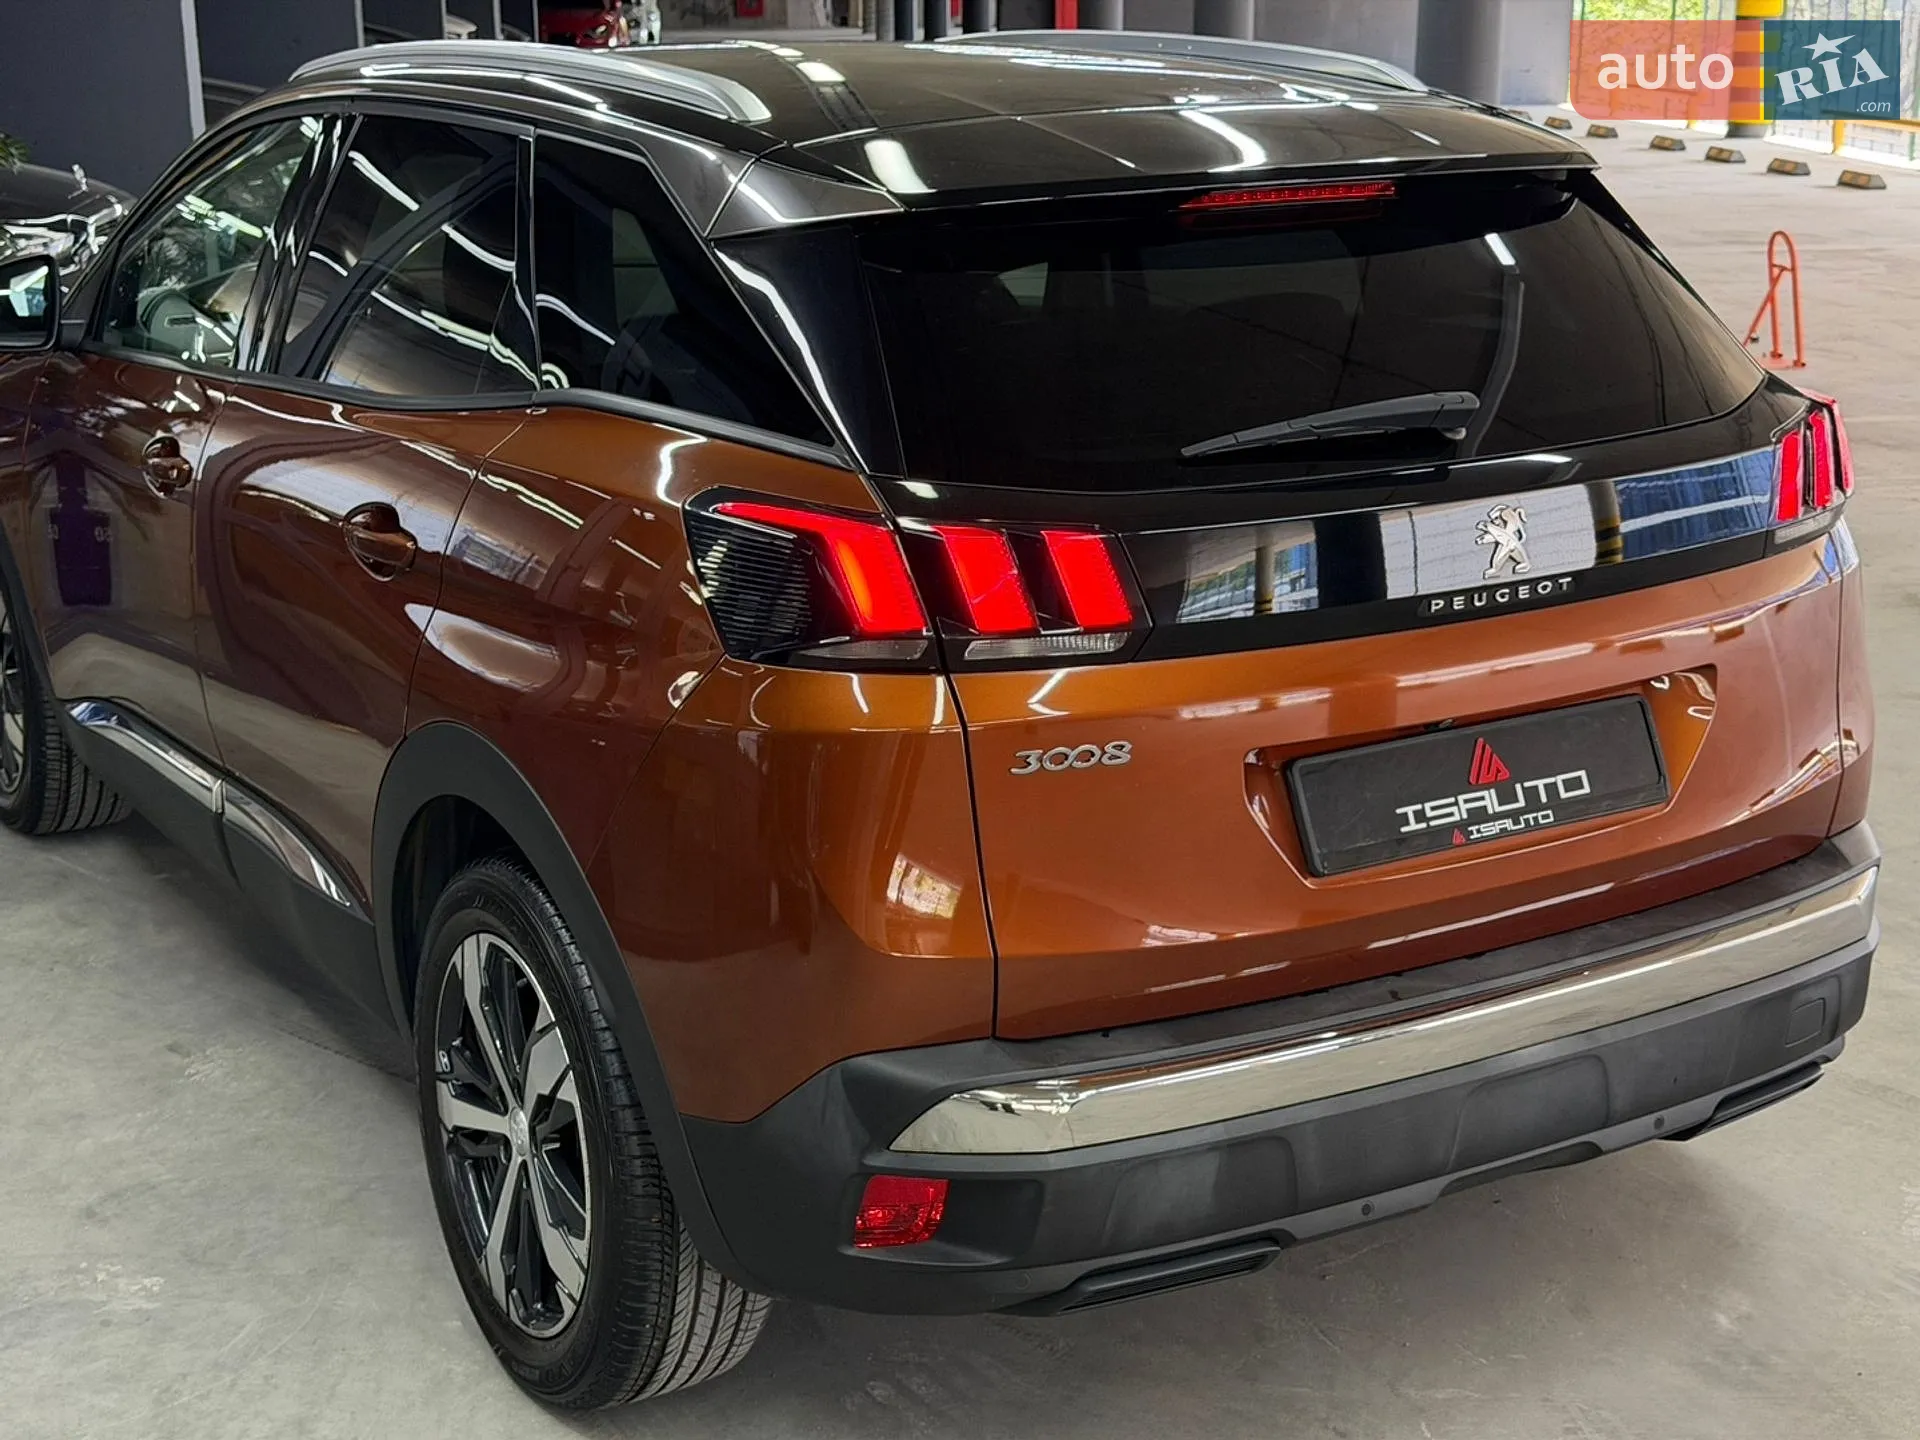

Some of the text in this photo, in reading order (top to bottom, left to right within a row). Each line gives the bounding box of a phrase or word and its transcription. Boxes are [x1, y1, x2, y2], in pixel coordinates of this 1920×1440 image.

[1430, 576, 1572, 613] PEUGEOT
[1010, 741, 1133, 774] 3008
[1395, 769, 1591, 833] ISAUTO
[1467, 810, 1555, 840] ISAUTO
